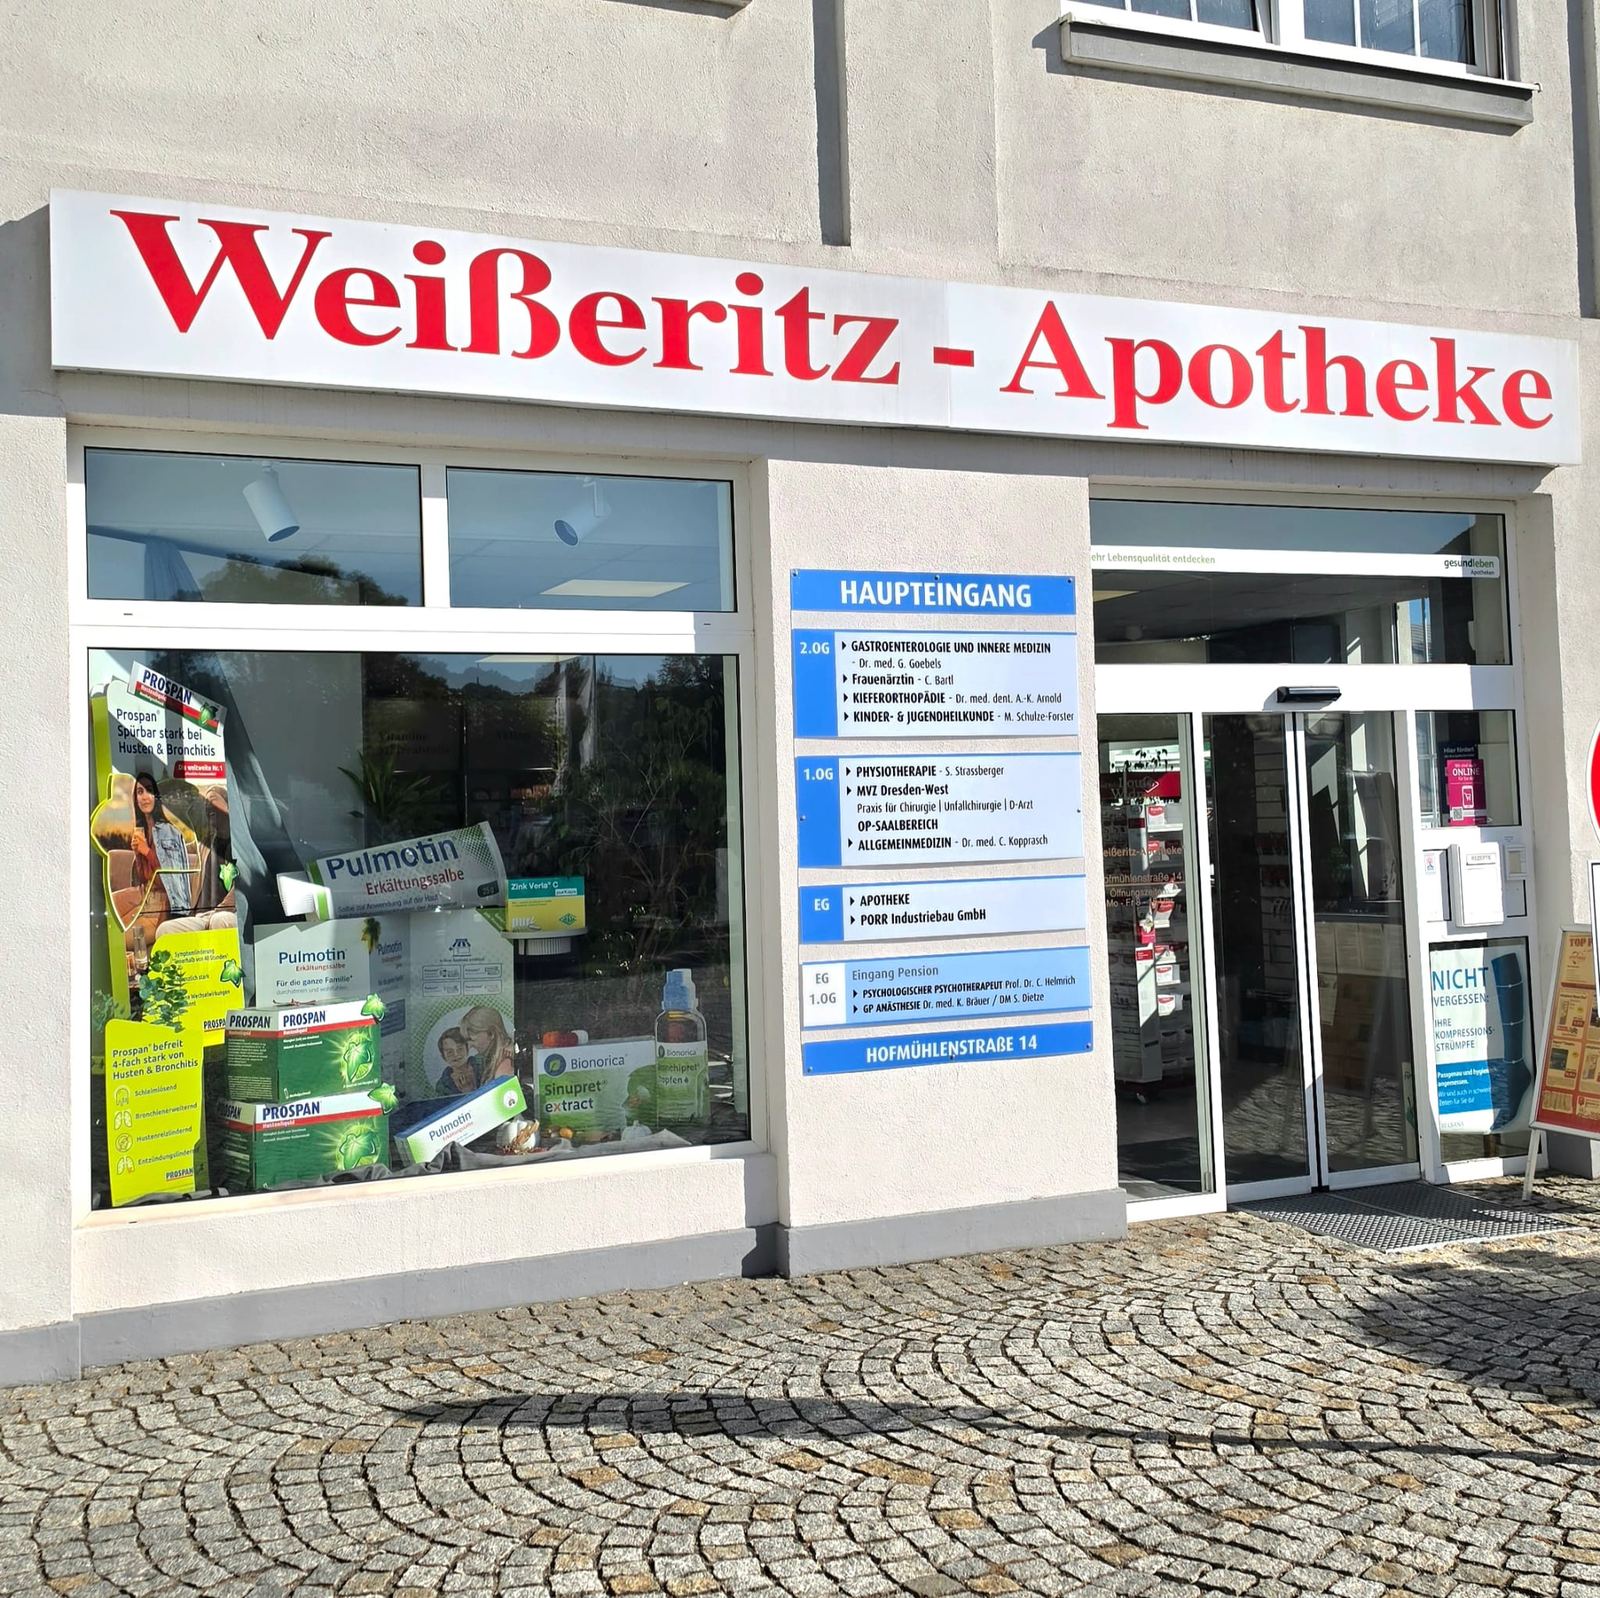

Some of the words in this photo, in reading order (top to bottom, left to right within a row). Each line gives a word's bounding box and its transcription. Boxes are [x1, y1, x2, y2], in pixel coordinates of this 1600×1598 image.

[110, 209, 901, 385] Weißeritz
[934, 346, 974, 367] -
[1000, 301, 1554, 429] Apotheke
[1091, 553, 1105, 562] ehr
[1107, 552, 1170, 564] Lebensqualität
[1172, 554, 1216, 564] entdecken
[1444, 557, 1494, 569] gesundleben
[840, 580, 1032, 608] HAUPTEINGANG
[851, 640, 952, 654] GASTROENTEROLOGIE
[954, 642, 974, 654] UND
[977, 642, 1010, 654] INNERE
[1014, 642, 1051, 654] MEDIZIN
[859, 658, 871, 668] Dr.
[874, 658, 895, 668] med.
[898, 658, 906, 669] G.
[909, 658, 942, 670] Goebels
[852, 673, 914, 686] Frauenärztin
[924, 675, 932, 686] C.
[934, 674, 954, 686] Bartl
[142, 669, 192, 705] PROSPAN
[852, 690, 946, 704] KIEFERORTHOPÄDIE
[955, 693, 968, 704] Dr.
[970, 693, 990, 704] med.
[992, 693, 1013, 704] dent.
[1015, 693, 1034, 704] A.-K.
[1036, 692, 1062, 704] Arnold
[853, 710, 894, 723] KINDER-
[896, 711, 904, 722] &
[906, 710, 994, 724] JUGENDHEILKUNDE
[1004, 712, 1014, 722] M.
[1016, 710, 1074, 722] Schulze-Forster
[118, 725, 156, 738] Spürbar
[160, 728, 184, 740] stark
[188, 728, 202, 740] bei
[119, 741, 154, 755] Husten
[156, 744, 164, 755] &
[166, 744, 216, 757] Bronchitis
[856, 766, 937, 778] PHYSIOTHERAPIE
[945, 766, 953, 777] S.
[954, 766, 1004, 778] Strassberger
[1452, 767, 1480, 776] ONLINE
[856, 784, 878, 797] MVZ
[880, 784, 949, 796] Dresden-West
[857, 802, 882, 814] Praxis
[885, 800, 897, 813] für
[900, 800, 936, 815] Chirurgie
[944, 799, 1002, 813] Unfallchirurgie
[1009, 799, 1034, 811] D-Arzt
[858, 819, 938, 832] OP-SAALBEREICH
[858, 836, 952, 851] ALLGEMEINMEDIZIN
[962, 836, 974, 848] Dr.
[976, 836, 996, 847] med.
[998, 836, 1006, 847] C.
[1008, 834, 1048, 848] Kopprasch
[326, 838, 460, 880] Pulmotin
[365, 868, 464, 896] Erkältungssalbe
[1104, 872, 1170, 884] ofmühlenstraße
[1172, 872, 1182, 880] 14
[510, 883, 528, 891] Zink
[1110, 888, 1169, 898] Öffnungszeite
[814, 898, 830, 911] EG
[860, 893, 910, 906] APOTHEKE
[1106, 899, 1118, 908] Mo
[1126, 898, 1134, 907] Fr
[1136, 898, 1141, 906] 8
[860, 914, 888, 926] PORR
[891, 910, 954, 924] Industriebau
[957, 908, 986, 921] GmbH
[378, 941, 403, 956] Pulmotin
[1570, 938, 1586, 947] TOP
[278, 948, 346, 964] Pulmotin
[296, 962, 346, 972] Erkältungssalbe
[852, 968, 894, 982] Eingang
[898, 965, 939, 978] Pension
[276, 979, 288, 987] Für
[290, 978, 300, 986] die
[302, 978, 323, 986] ganze
[815, 972, 829, 984] EG
[1432, 967, 1488, 992] NICHT
[862, 985, 932, 999] PSYCHOLOGISCHER
[934, 981, 1003, 996] PSYCHOTHERAPEUT
[1004, 978, 1022, 989] Prof.
[1024, 978, 1034, 988] Dr.
[1036, 976, 1044, 987] C.
[1045, 974, 1076, 986] Helmrich
[863, 1004, 874, 1014] GP
[876, 1000, 921, 1013] ANÄSTHESIE
[923, 1000, 934, 1010] Dr.
[936, 998, 954, 1009] med.
[956, 997, 964, 1008] K.
[966, 995, 990, 1007] Bräuer
[999, 994, 1012, 1005] DM
[1014, 993, 1020, 1004] S.
[1022, 992, 1045, 1004] Dietze
[1434, 994, 1490, 1008] VERGESSEN:
[204, 1019, 226, 1030] PROSPA
[229, 1014, 271, 1029] PROSPAN
[282, 1010, 326, 1028] PROSPAN
[1435, 1018, 1452, 1028] IHRE
[1436, 1026, 1496, 1040] KOMPRESSIONS-
[152, 1040, 184, 1052] befreit
[666, 1048, 696, 1057] Bionorica
[866, 1036, 1014, 1064] HOFMÜHLENSTRAßE
[1018, 1034, 1038, 1051] 14
[1436, 1039, 1476, 1052] STRÜMPFE
[112, 1055, 141, 1068] 4-fach
[143, 1052, 166, 1064] stark
[168, 1051, 184, 1060] von
[570, 1055, 624, 1071] Bionorica
[112, 1066, 144, 1080] Husten
[146, 1066, 153, 1074] &
[155, 1059, 198, 1073] Bronchitis
[134, 1084, 178, 1097] Schleimlösend
[134, 1102, 198, 1120] Bronchienerweiternd
[262, 1101, 320, 1121] PROSPAN
[545, 1097, 594, 1114] extract
[428, 1111, 472, 1142] Pulmotin
[136, 1126, 192, 1142] Hustenreizlindernd
[166, 1168, 194, 1180] PROSPAN
